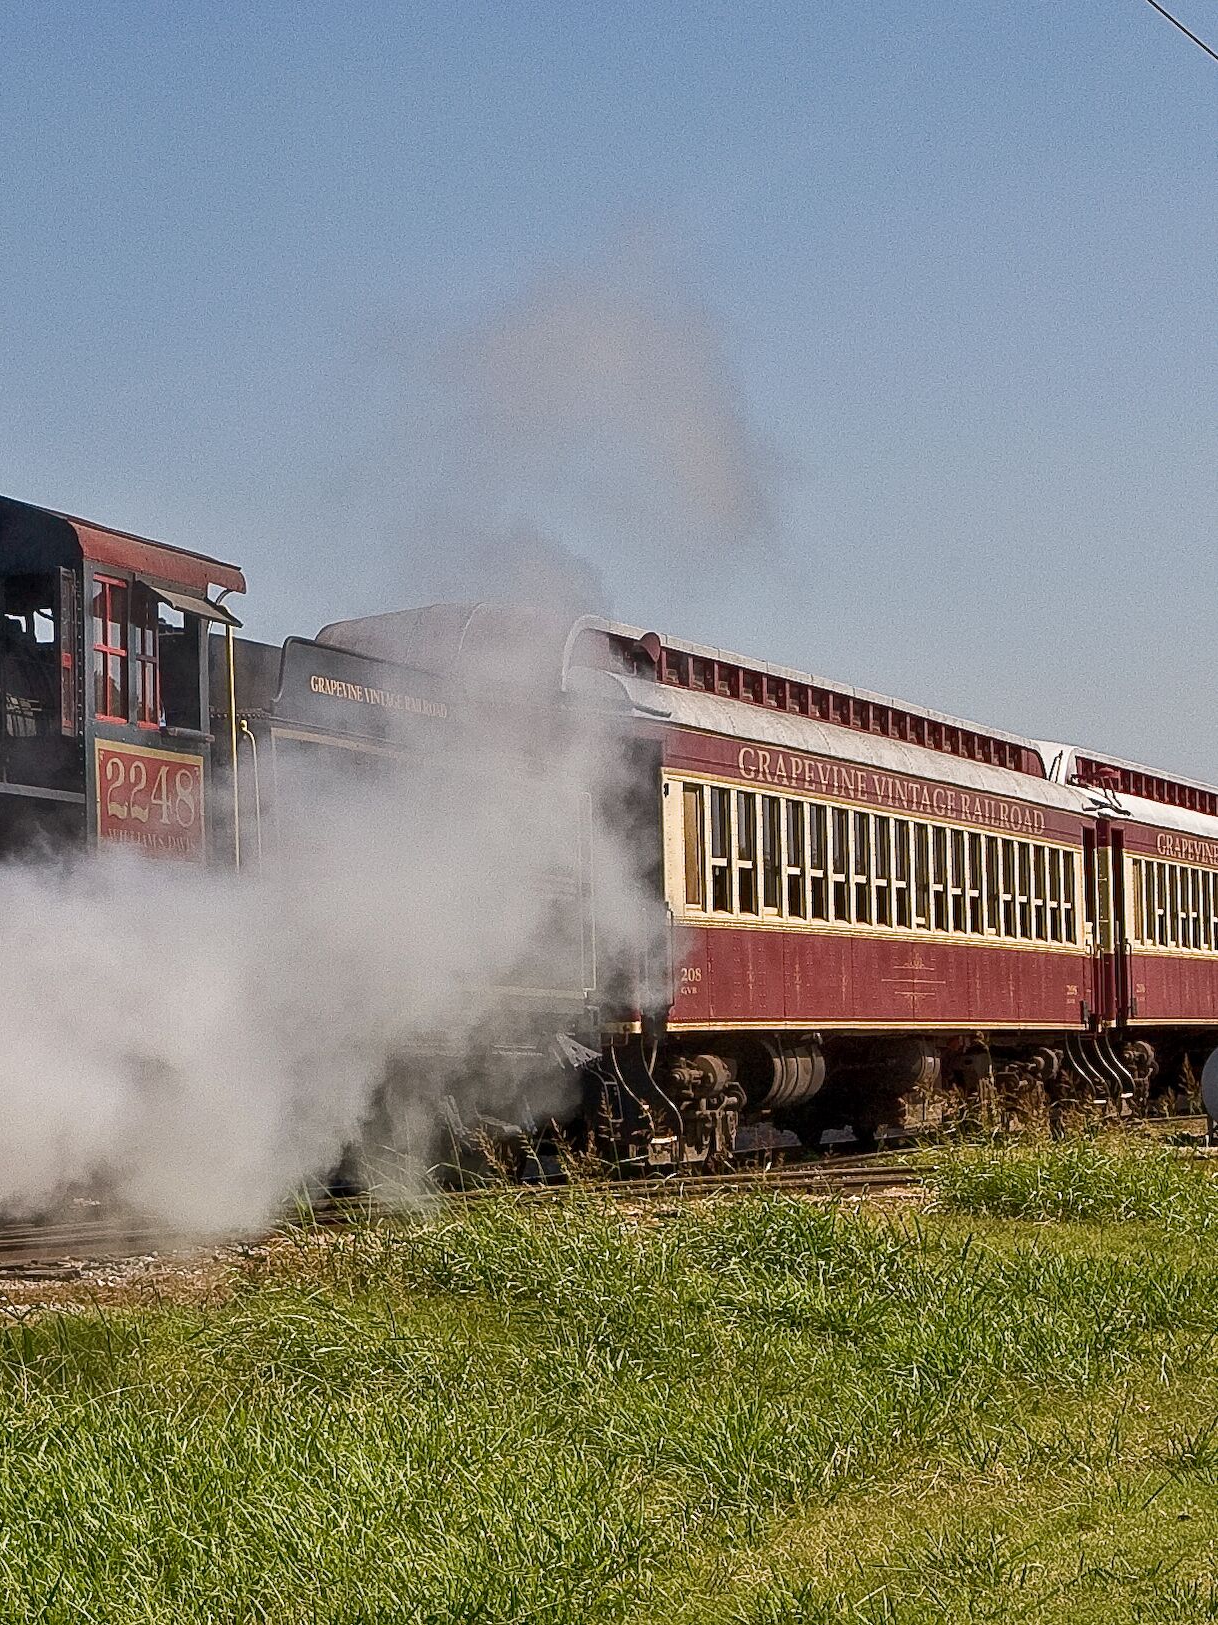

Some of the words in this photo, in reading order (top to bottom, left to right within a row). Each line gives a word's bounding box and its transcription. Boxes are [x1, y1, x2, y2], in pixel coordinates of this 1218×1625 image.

[310, 675, 364, 702] GRAPEVINE
[364, 687, 403, 710] VINTAGE
[106, 757, 195, 828] 2248
[738, 747, 867, 800] GRAPEVINE
[873, 775, 956, 818] VINTAGE
[960, 793, 1045, 835] RAILROAD
[681, 967, 702, 982] 208
